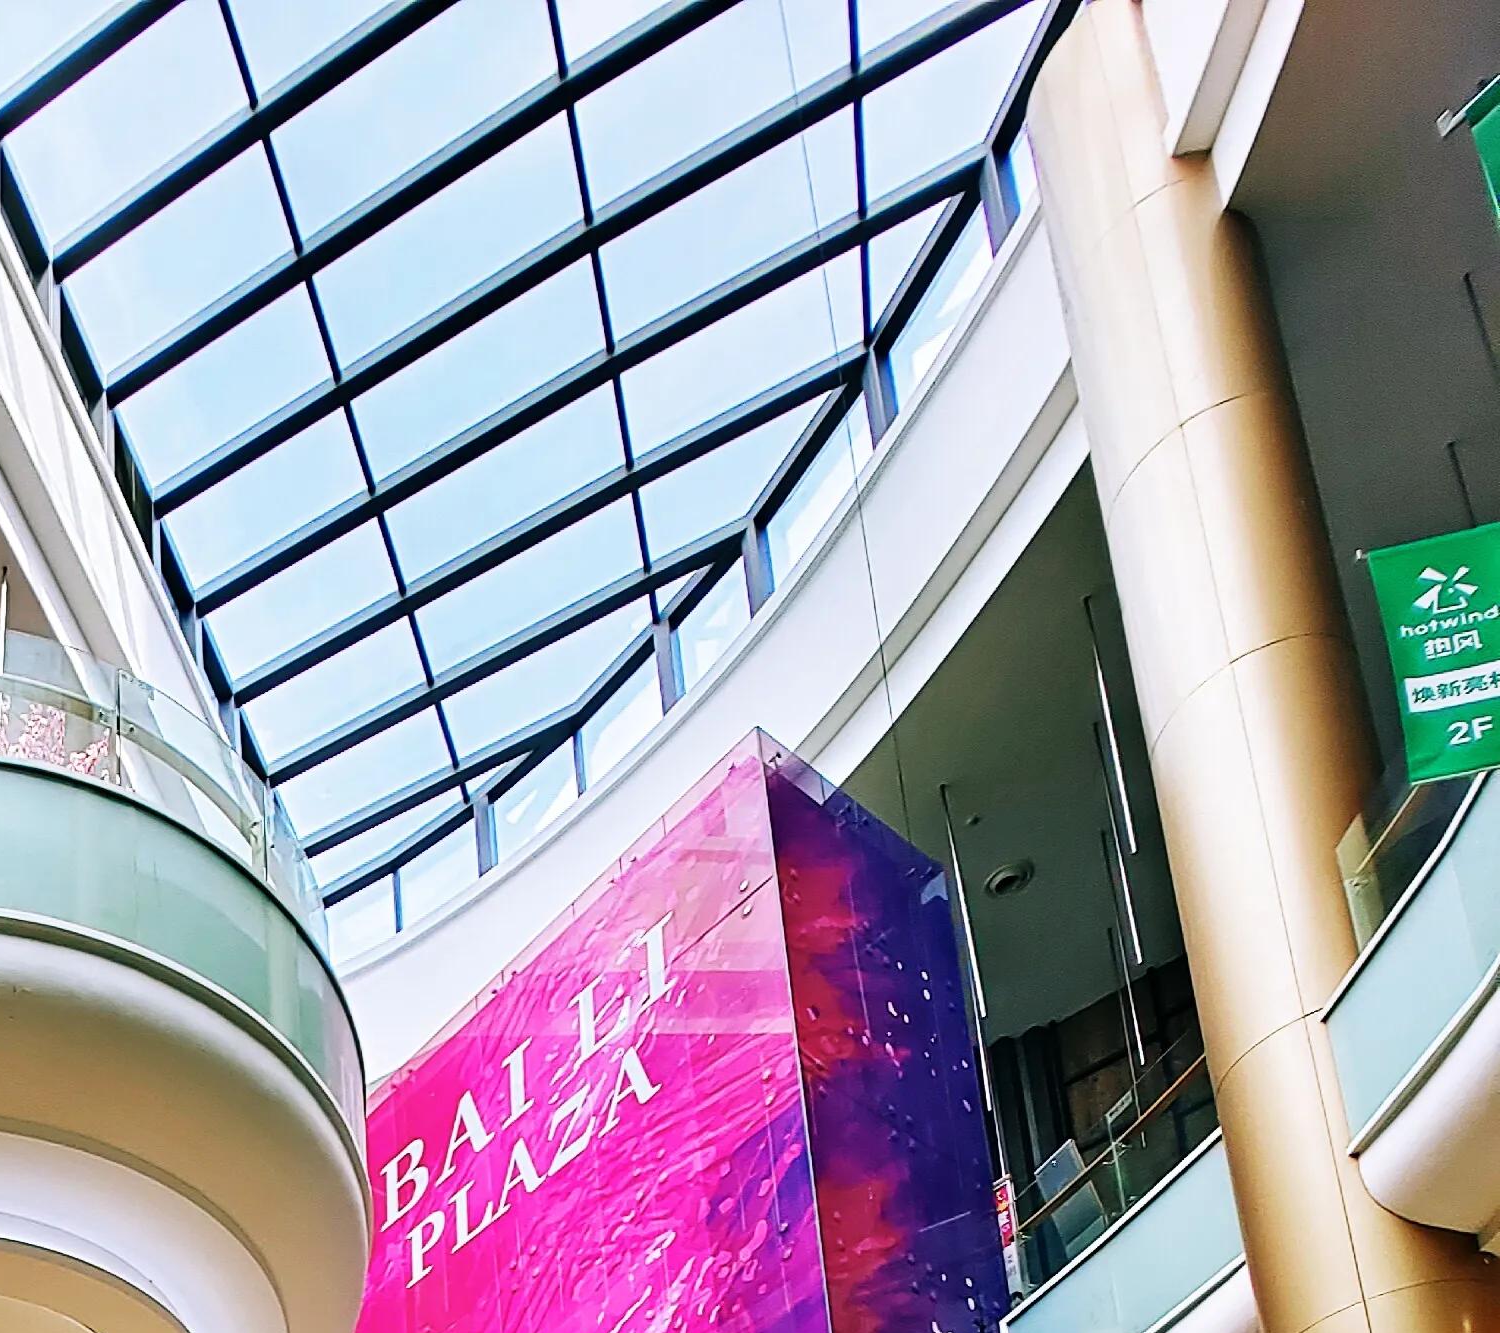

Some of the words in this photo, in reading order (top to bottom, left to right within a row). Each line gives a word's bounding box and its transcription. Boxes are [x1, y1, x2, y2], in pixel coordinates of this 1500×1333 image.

[1401, 604, 1500, 638] hotwind
[1424, 629, 1483, 660] 热风
[1447, 715, 1493, 745] 2F
[405, 1046, 662, 1290] PLAZA
